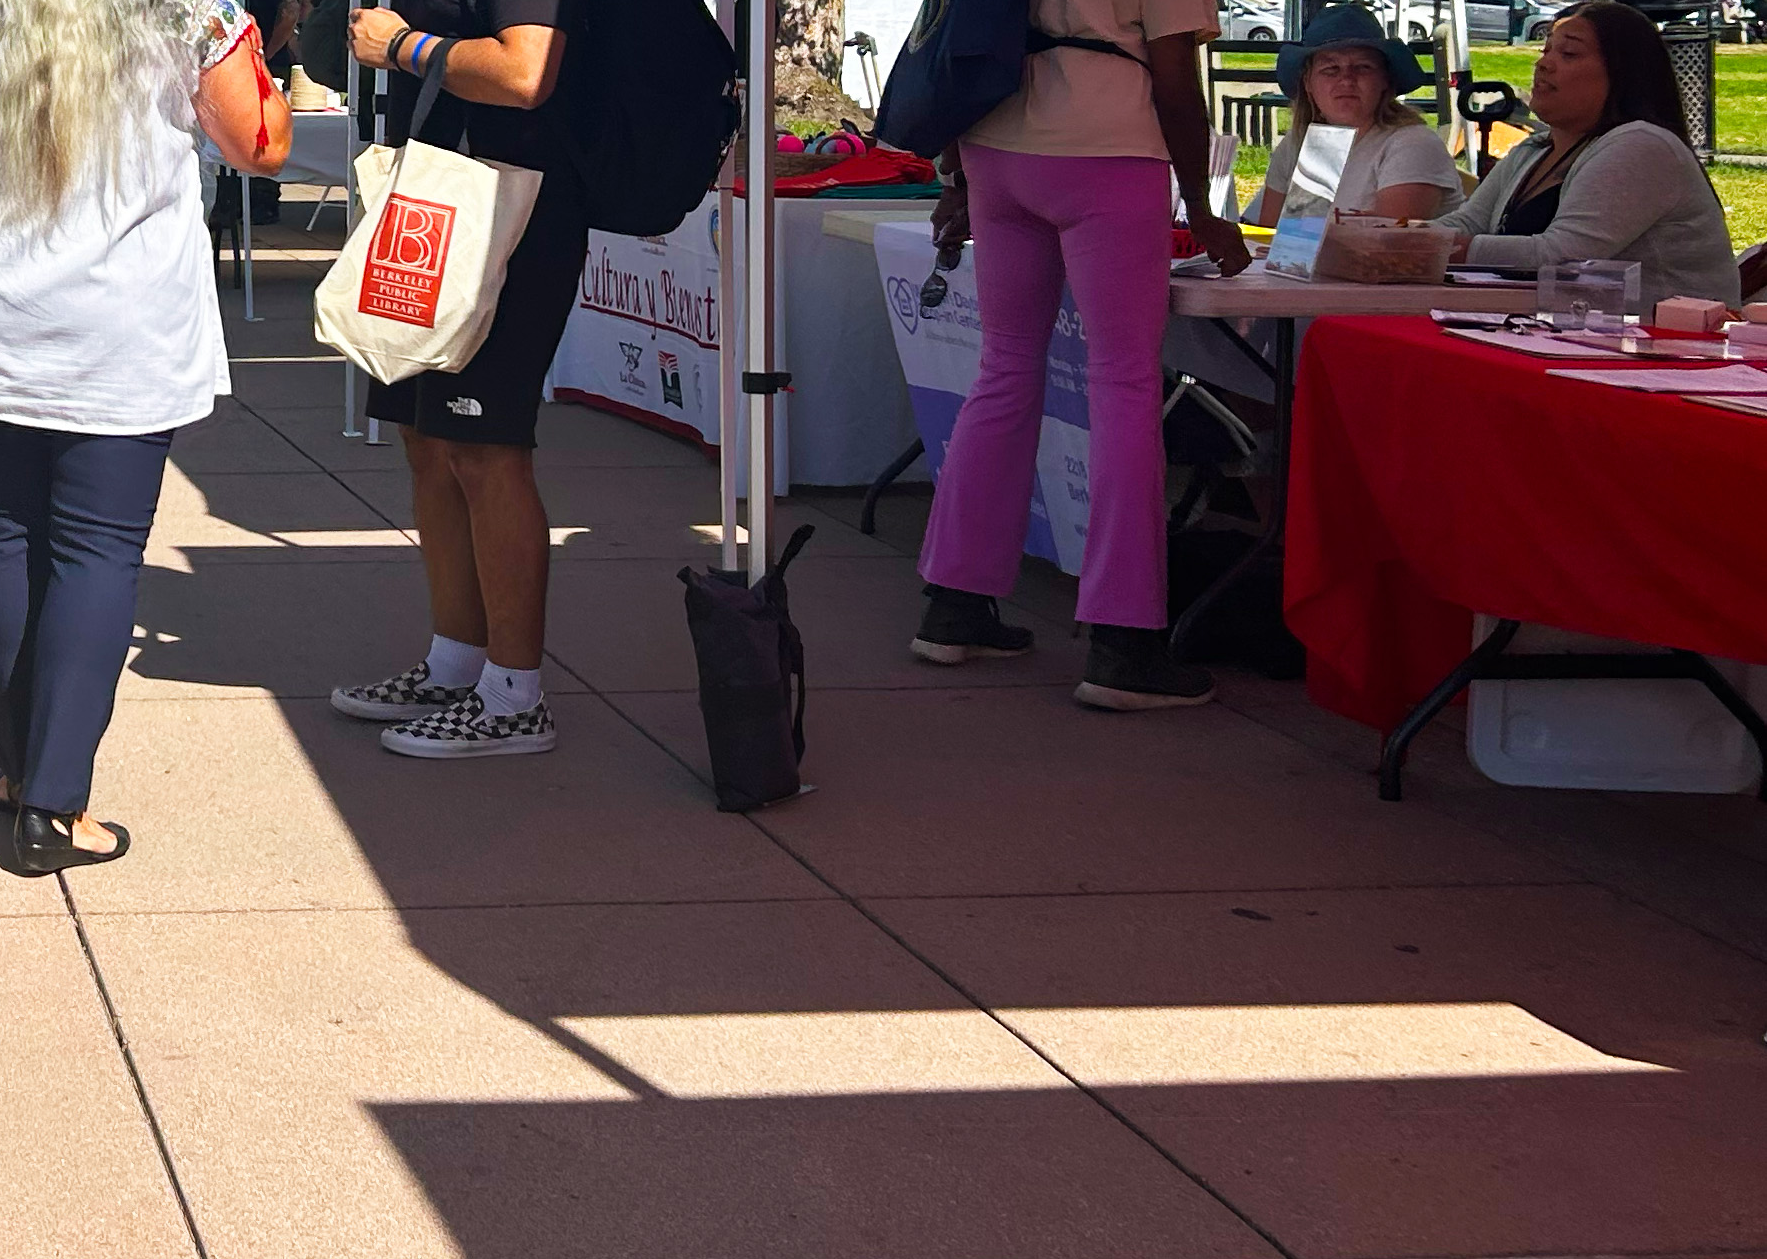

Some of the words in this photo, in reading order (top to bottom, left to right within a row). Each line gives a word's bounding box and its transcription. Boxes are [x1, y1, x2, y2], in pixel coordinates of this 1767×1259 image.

[372, 267, 434, 289] BERKELEY
[379, 284, 422, 302] PUBLIC
[581, 246, 642, 316] Cultura
[645, 277, 657, 341] y
[660, 270, 720, 341] Bienst
[372, 297, 423, 317] LIBRARY
